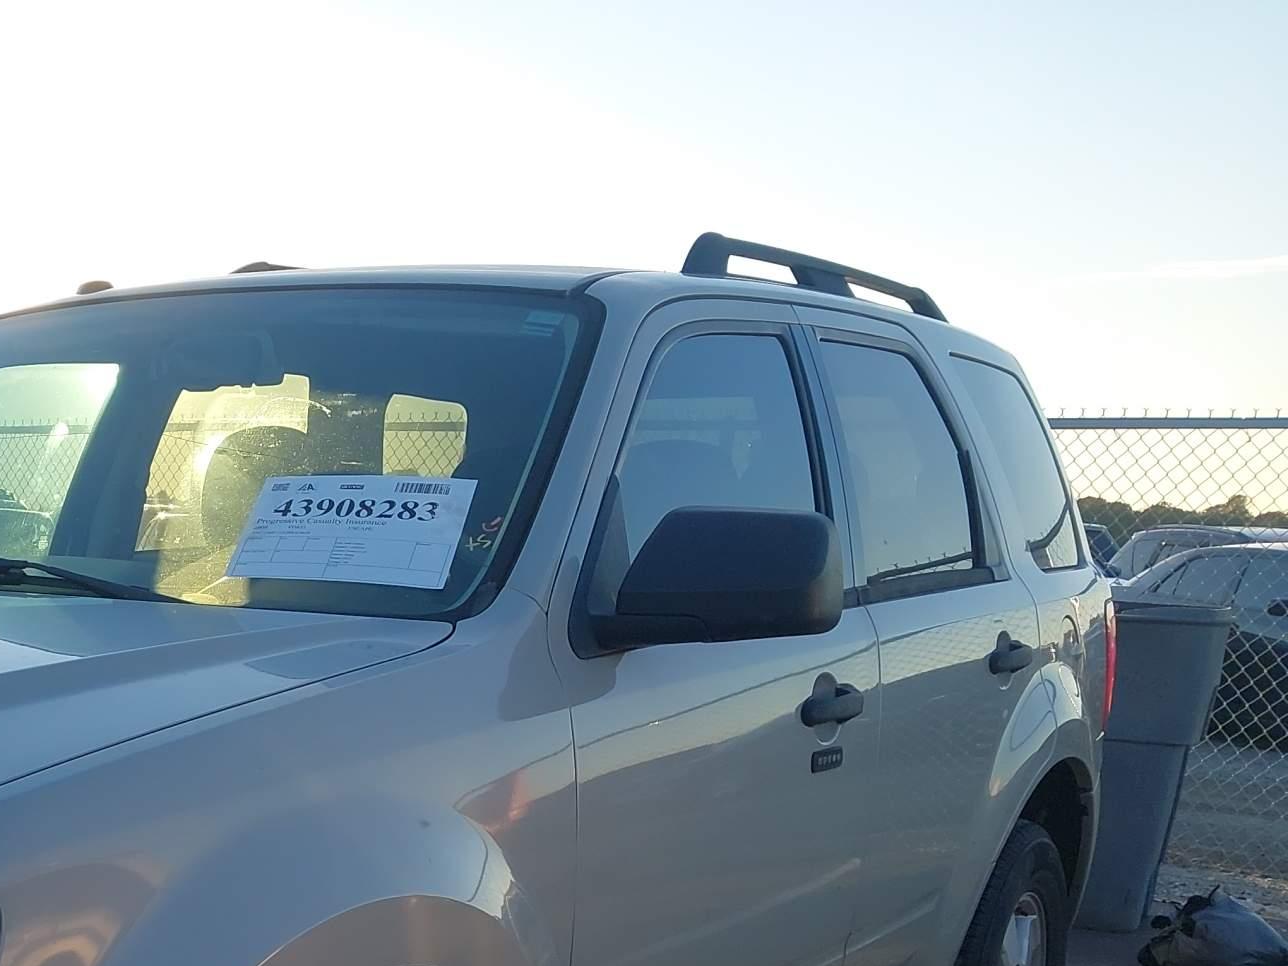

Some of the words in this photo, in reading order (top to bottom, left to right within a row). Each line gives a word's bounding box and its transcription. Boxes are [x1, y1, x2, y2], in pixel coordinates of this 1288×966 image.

[273, 498, 440, 522] 43908283
[256, 517, 305, 526] Progressive
[306, 518, 342, 526] Casualty
[345, 518, 388, 527] Insurance
